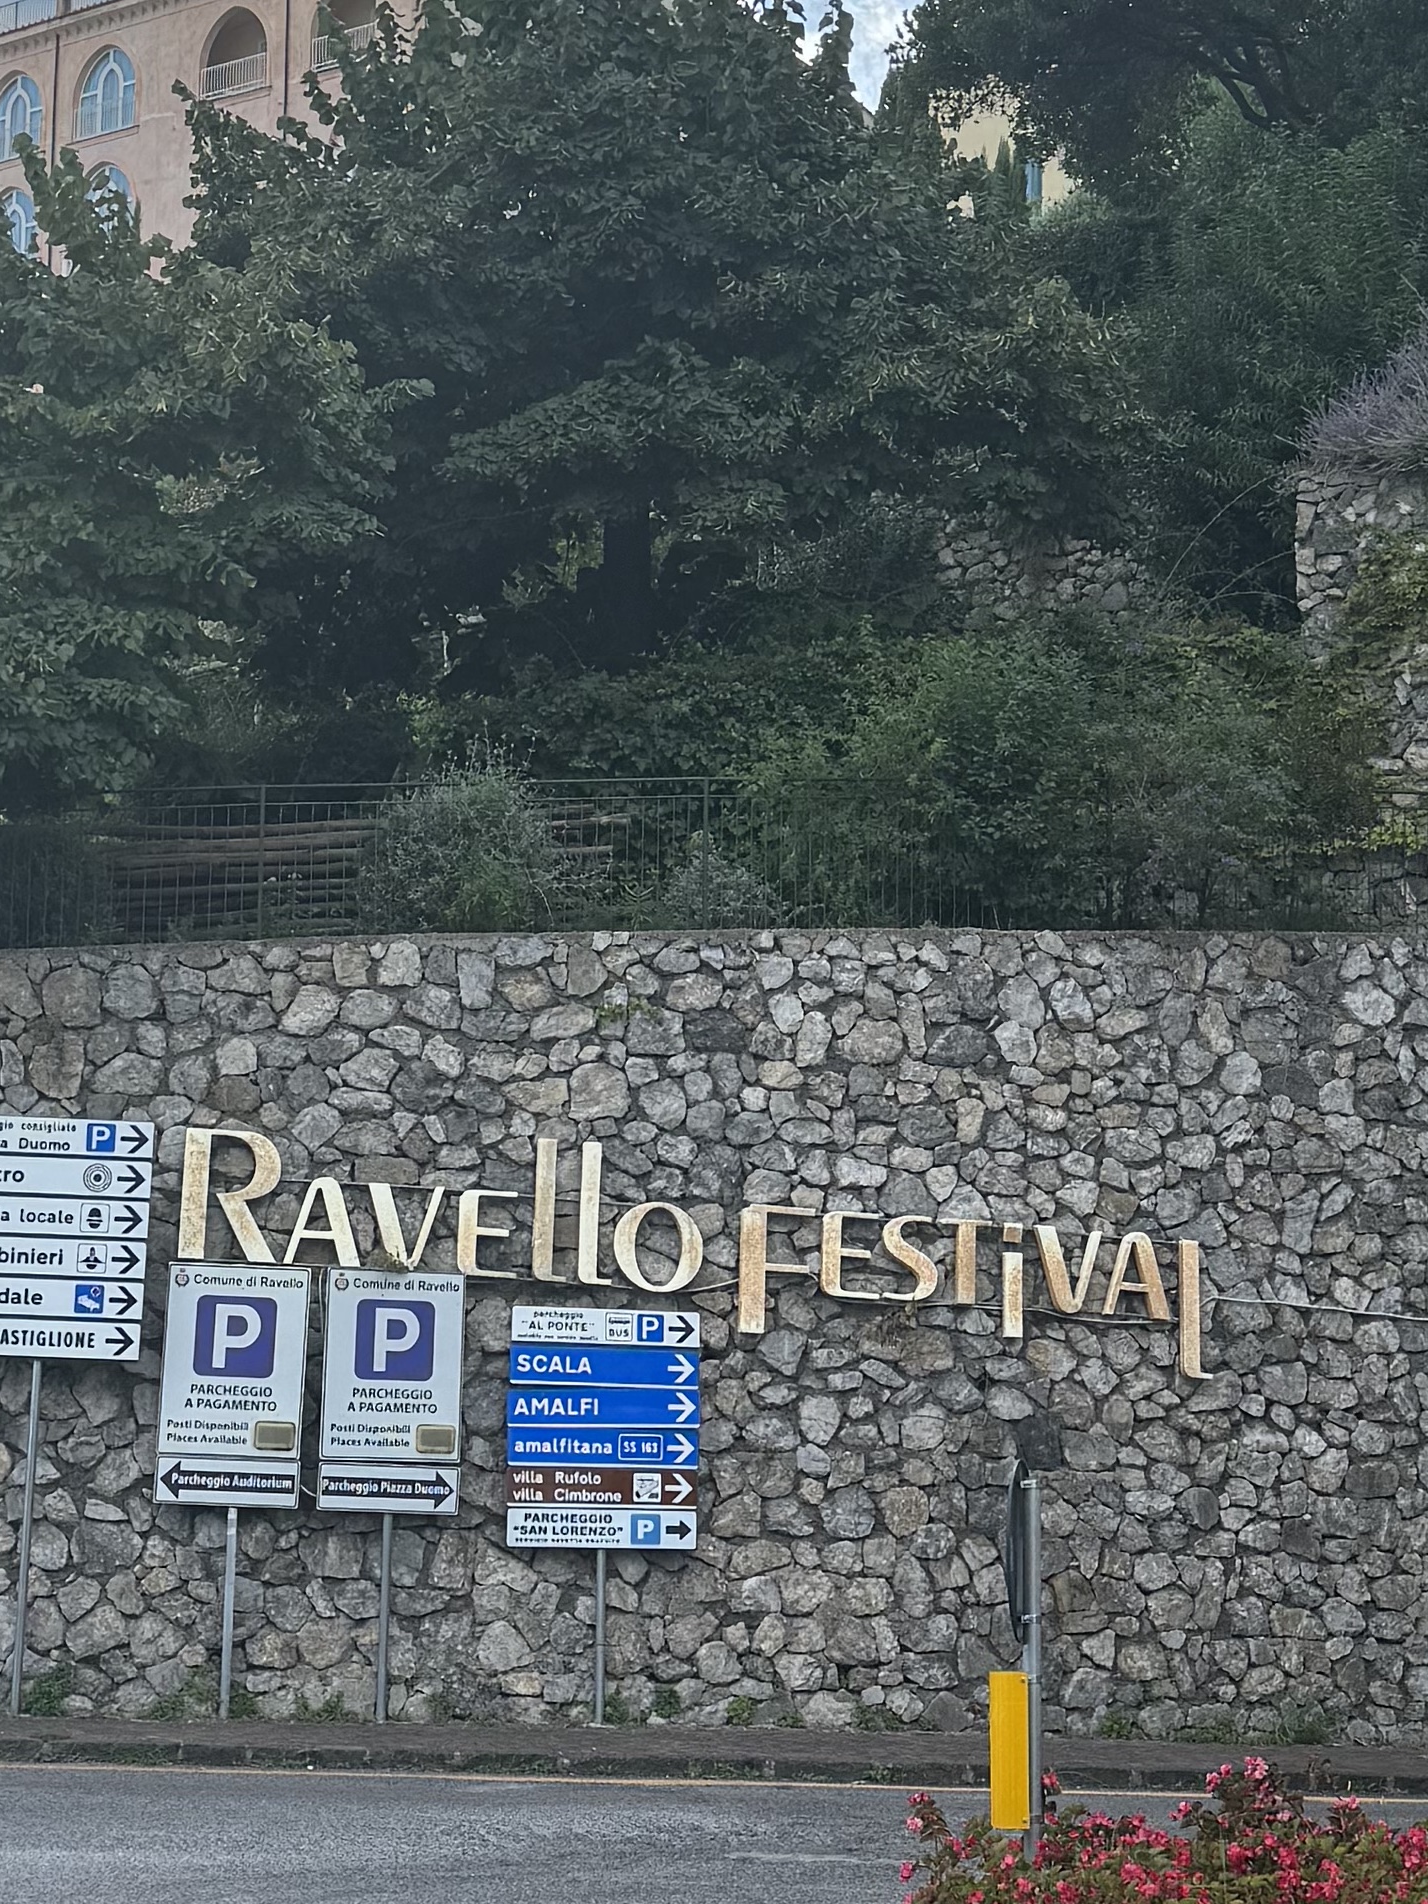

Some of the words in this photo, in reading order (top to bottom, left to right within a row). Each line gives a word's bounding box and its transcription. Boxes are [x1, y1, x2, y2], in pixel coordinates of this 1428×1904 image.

[21, 1121, 77, 1134] consigliato
[18, 1137, 71, 1151] Duomo
[91, 1125, 111, 1149] P
[19, 1208, 74, 1225] locale
[194, 1273, 243, 1287] Comune
[246, 1276, 257, 1287] di
[260, 1276, 304, 1289] Ravello
[353, 1278, 400, 1290] Comune
[404, 1280, 414, 1291] di
[418, 1280, 460, 1293] Ravello
[533, 1311, 584, 1320] parcheggio
[212, 1303, 262, 1368] P
[609, 1328, 629, 1337] BUS
[642, 1317, 659, 1339] P
[373, 1307, 420, 1372] P
[516, 1354, 592, 1374] SCALA
[190, 1383, 273, 1397] PARCHEGGIO
[352, 1387, 433, 1400] PARCHEGGIO
[184, 1398, 193, 1408] A
[196, 1398, 277, 1412] PAGAMENTO
[347, 1402, 355, 1412] A
[359, 1402, 438, 1414] PAGAMENTO
[514, 1398, 599, 1416] AMALFI
[166, 1419, 192, 1429] Posti
[194, 1420, 249, 1431] Disponibili
[330, 1423, 355, 1433] Posti
[357, 1424, 411, 1435] Disponibili
[166, 1433, 198, 1443] Places
[200, 1434, 247, 1444] Available
[330, 1437, 361, 1446] Places
[363, 1437, 410, 1447] Available
[514, 1437, 613, 1454] amalfitana
[623, 1441, 637, 1453] SS
[641, 1441, 658, 1453] 163
[171, 1472, 229, 1488] Parcheggio
[232, 1474, 292, 1489] Auditorium
[512, 1470, 543, 1484] villa
[554, 1471, 602, 1485] Rufolo
[322, 1478, 378, 1495] Parcheggio
[380, 1481, 412, 1494] Piazza
[414, 1482, 450, 1495] Duomo
[512, 1488, 543, 1501] villa
[554, 1488, 622, 1503] Cimbrone
[524, 1513, 613, 1524] PARCHEGGIO
[638, 1519, 655, 1539] P
